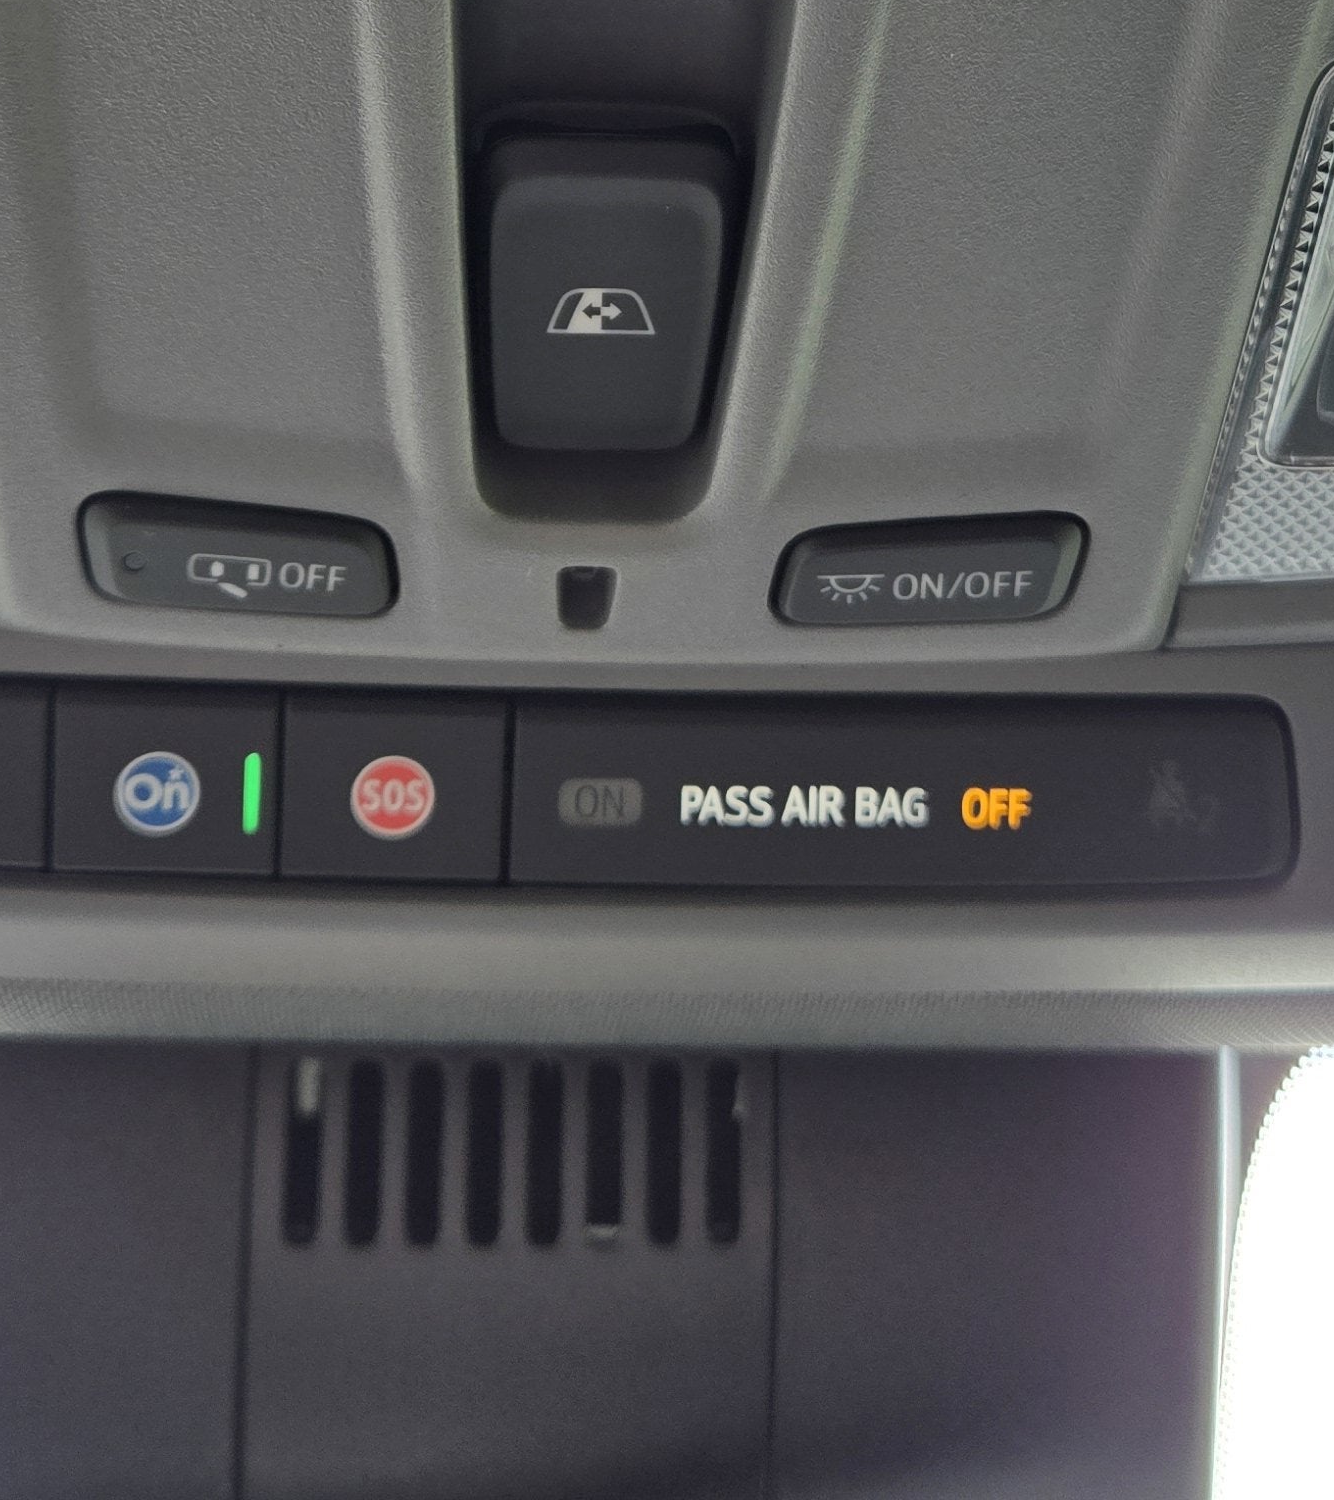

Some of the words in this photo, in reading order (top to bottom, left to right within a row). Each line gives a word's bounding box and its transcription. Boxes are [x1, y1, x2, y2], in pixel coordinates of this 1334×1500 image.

[279, 562, 347, 592] OFF
[892, 569, 1034, 602] ON/OFF
[359, 778, 426, 814] SOS
[573, 784, 626, 820] ON
[679, 784, 776, 827] PASS
[780, 784, 847, 828] AIR
[854, 785, 930, 828] BAG
[961, 787, 1032, 830] OFF
